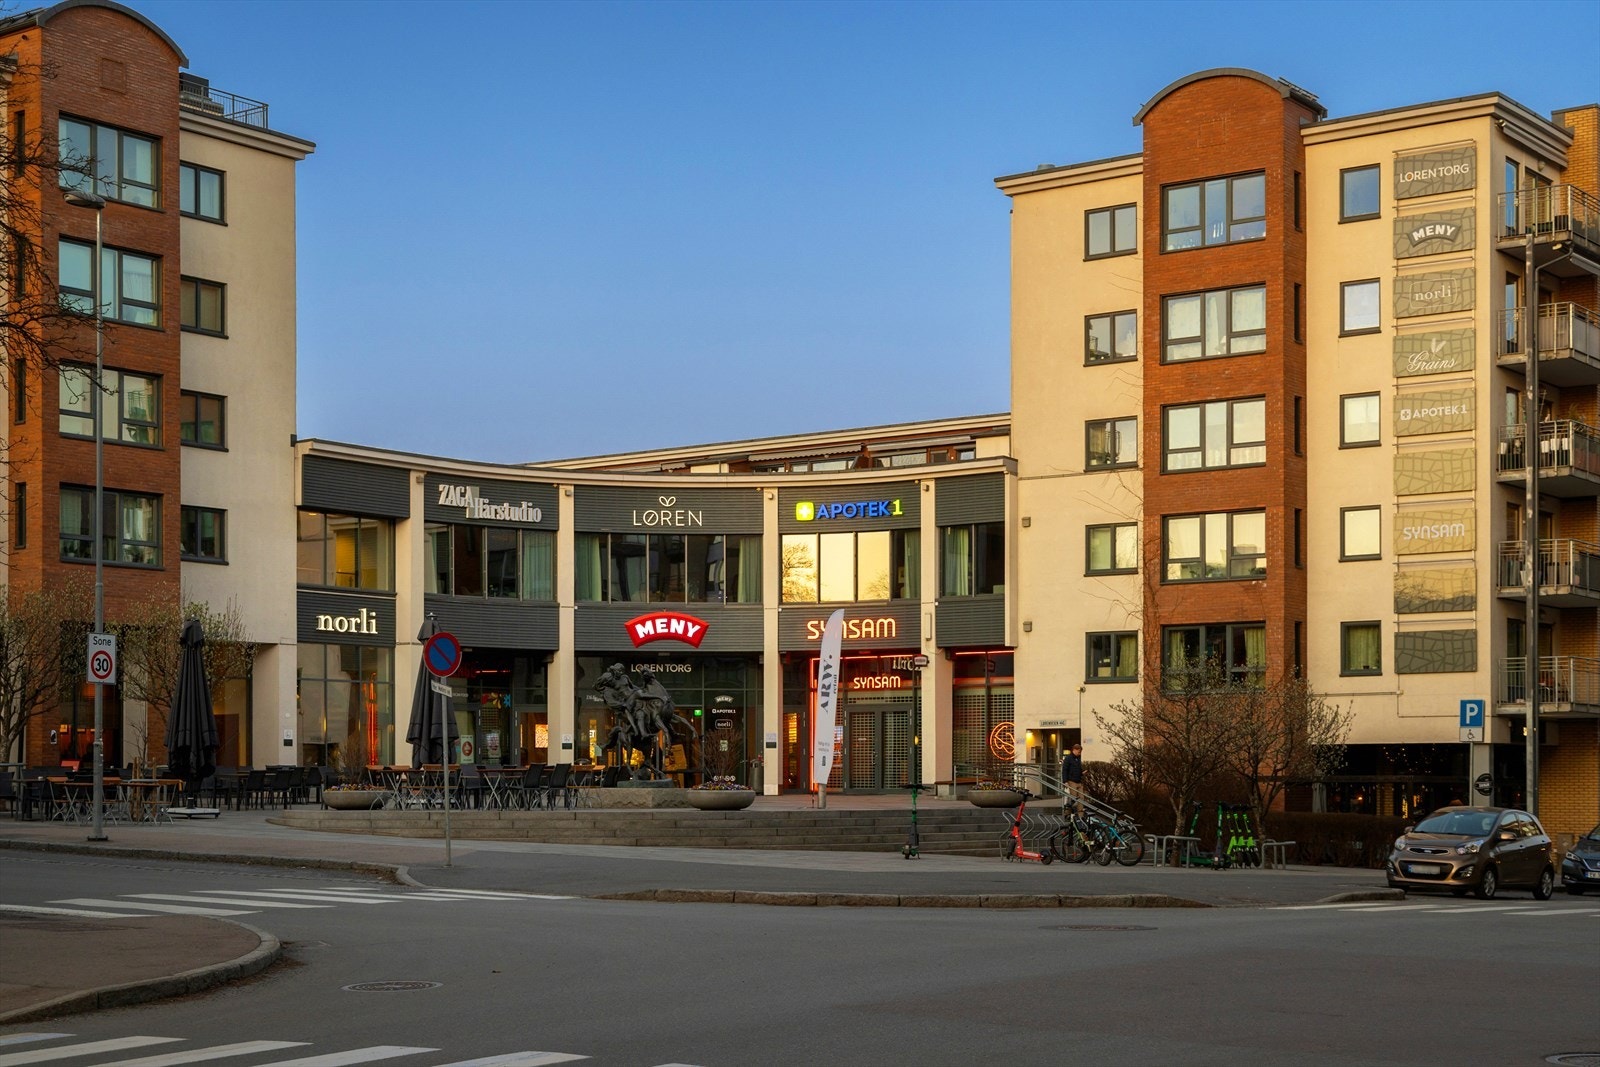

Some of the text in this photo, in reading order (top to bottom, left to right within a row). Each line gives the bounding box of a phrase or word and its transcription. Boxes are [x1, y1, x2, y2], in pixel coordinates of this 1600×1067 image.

[1438, 163, 1470, 177] TORG
[1412, 224, 1456, 242] MENY
[1415, 285, 1452, 302] norli
[1406, 351, 1457, 373] Grains
[1413, 404, 1467, 420] APOTEK 1
[474, 497, 542, 523] Hårstudio
[816, 499, 903, 519] APOTEK 1
[633, 510, 702, 526] LØREN
[1403, 523, 1465, 541] SYNSAM
[316, 608, 378, 635] norli
[634, 618, 701, 639] MENY
[92, 636, 112, 646] Sone
[95, 657, 109, 672] 30
[664, 664, 692, 673] TORG
[853, 676, 901, 690] SYNSAM
[1466, 703, 1478, 725] P
